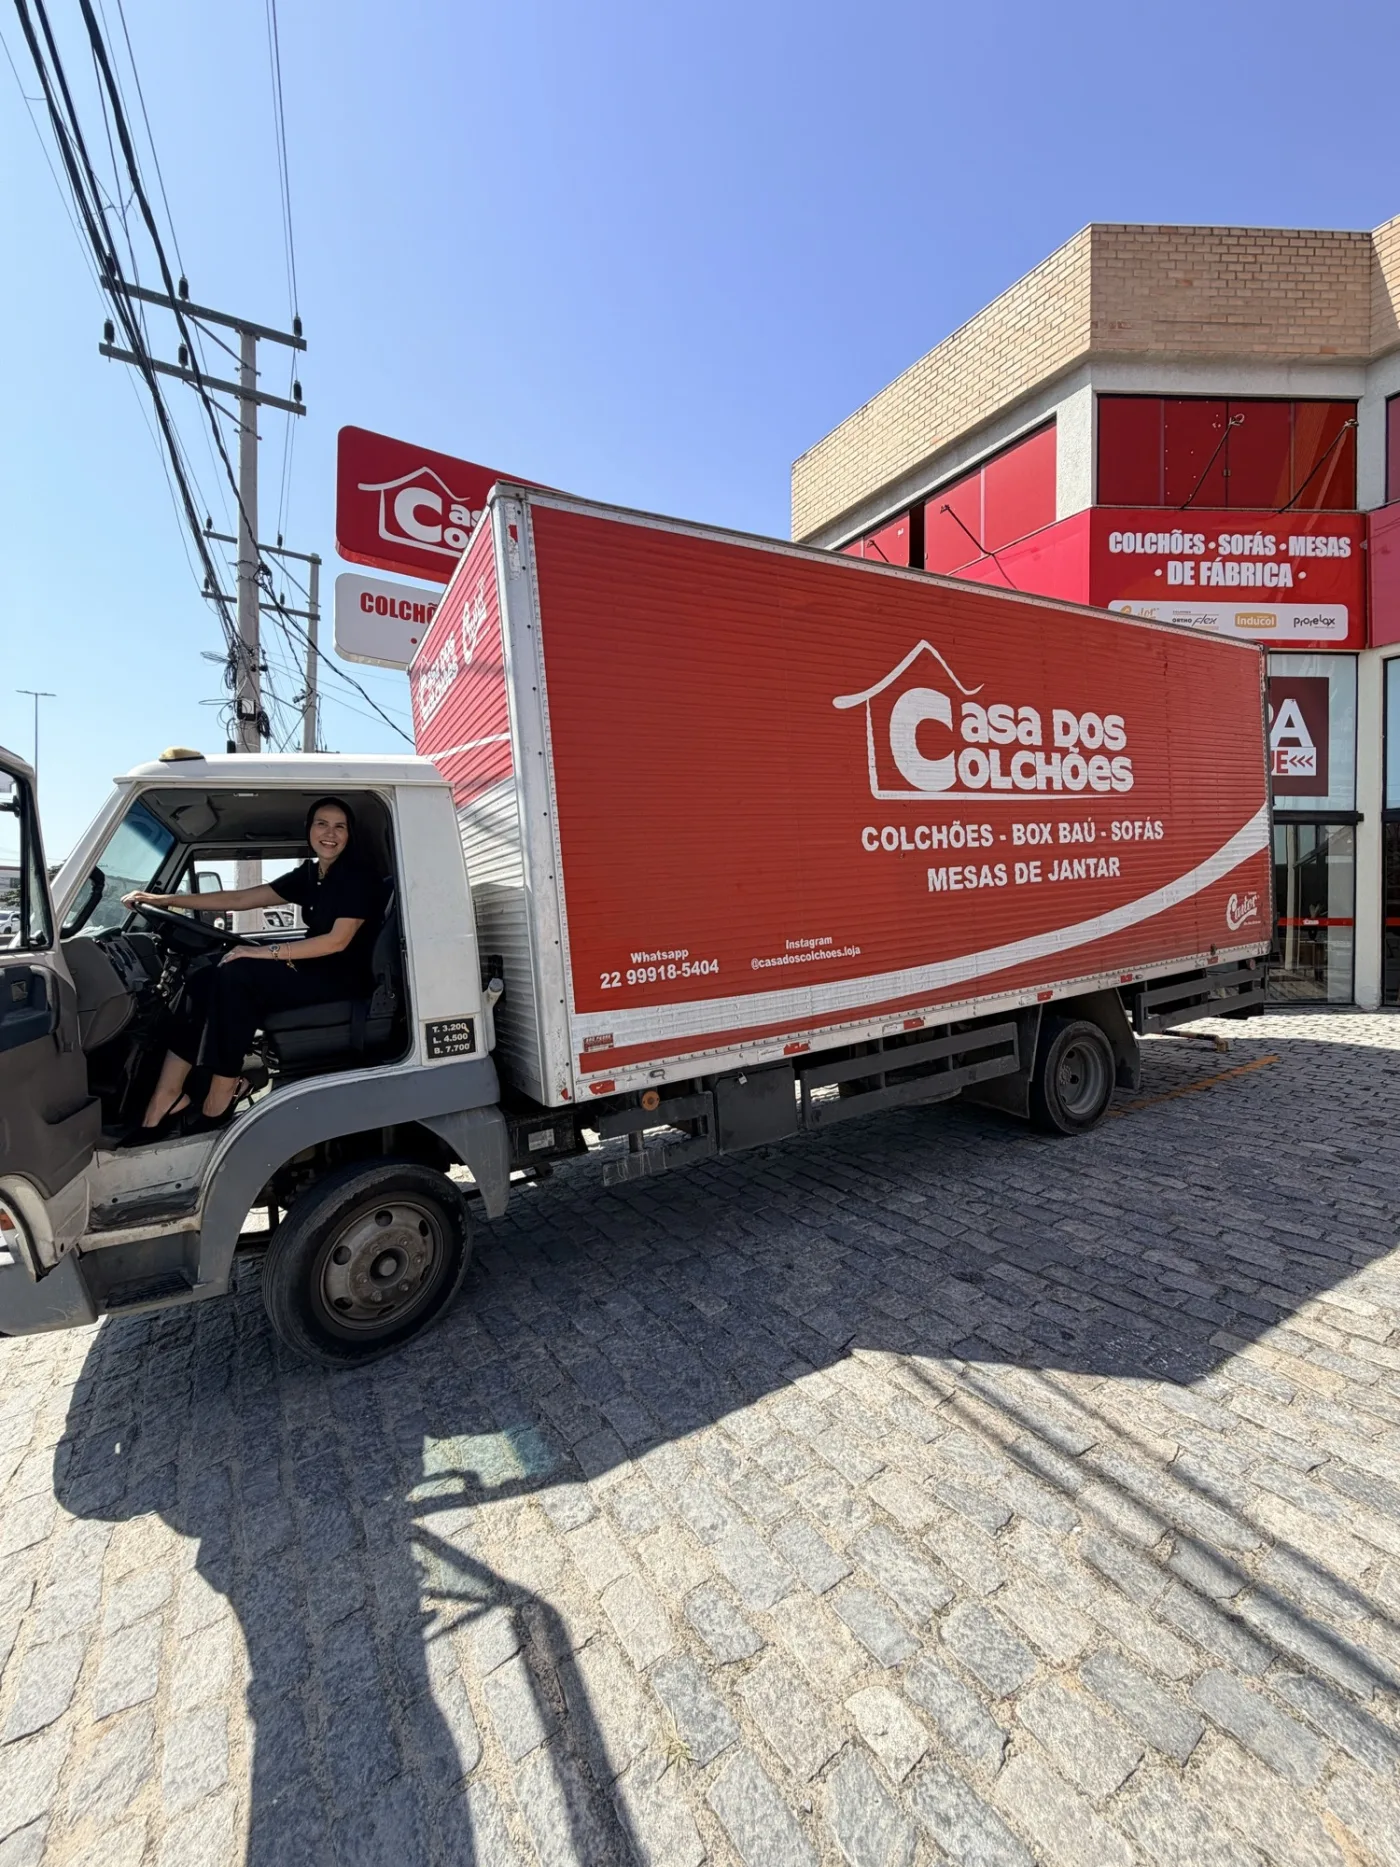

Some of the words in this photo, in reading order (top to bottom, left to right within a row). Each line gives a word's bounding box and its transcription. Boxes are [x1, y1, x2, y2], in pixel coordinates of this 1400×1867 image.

[1109, 529, 1205, 555] COLCHÕES
[1218, 531, 1276, 556] SOFÁS
[1288, 536, 1351, 558] MESAS
[1167, 561, 1195, 585] DE
[1200, 557, 1293, 587] FÁBRICA
[1237, 616, 1275, 626] Inducol
[1052, 709, 1127, 751] DOS
[861, 820, 993, 851] COLCHÕES
[1012, 823, 1053, 846] BOX
[1059, 817, 1096, 843] BAÚ
[1111, 816, 1164, 841] SOFÁS
[927, 864, 1008, 892] MESAS
[1014, 861, 1042, 882] DE
[1048, 857, 1120, 881] JANTAR
[785, 936, 833, 950] Instagram
[630, 949, 689, 964] Whatsapp
[751, 945, 861, 970] @casadoscolchoes.loja
[600, 972, 622, 989] 22
[626, 959, 719, 985] 99918-5404
[442, 1022, 467, 1032] 3.200
[443, 1033, 468, 1042] 4.500
[445, 1043, 470, 1053] 7.700
